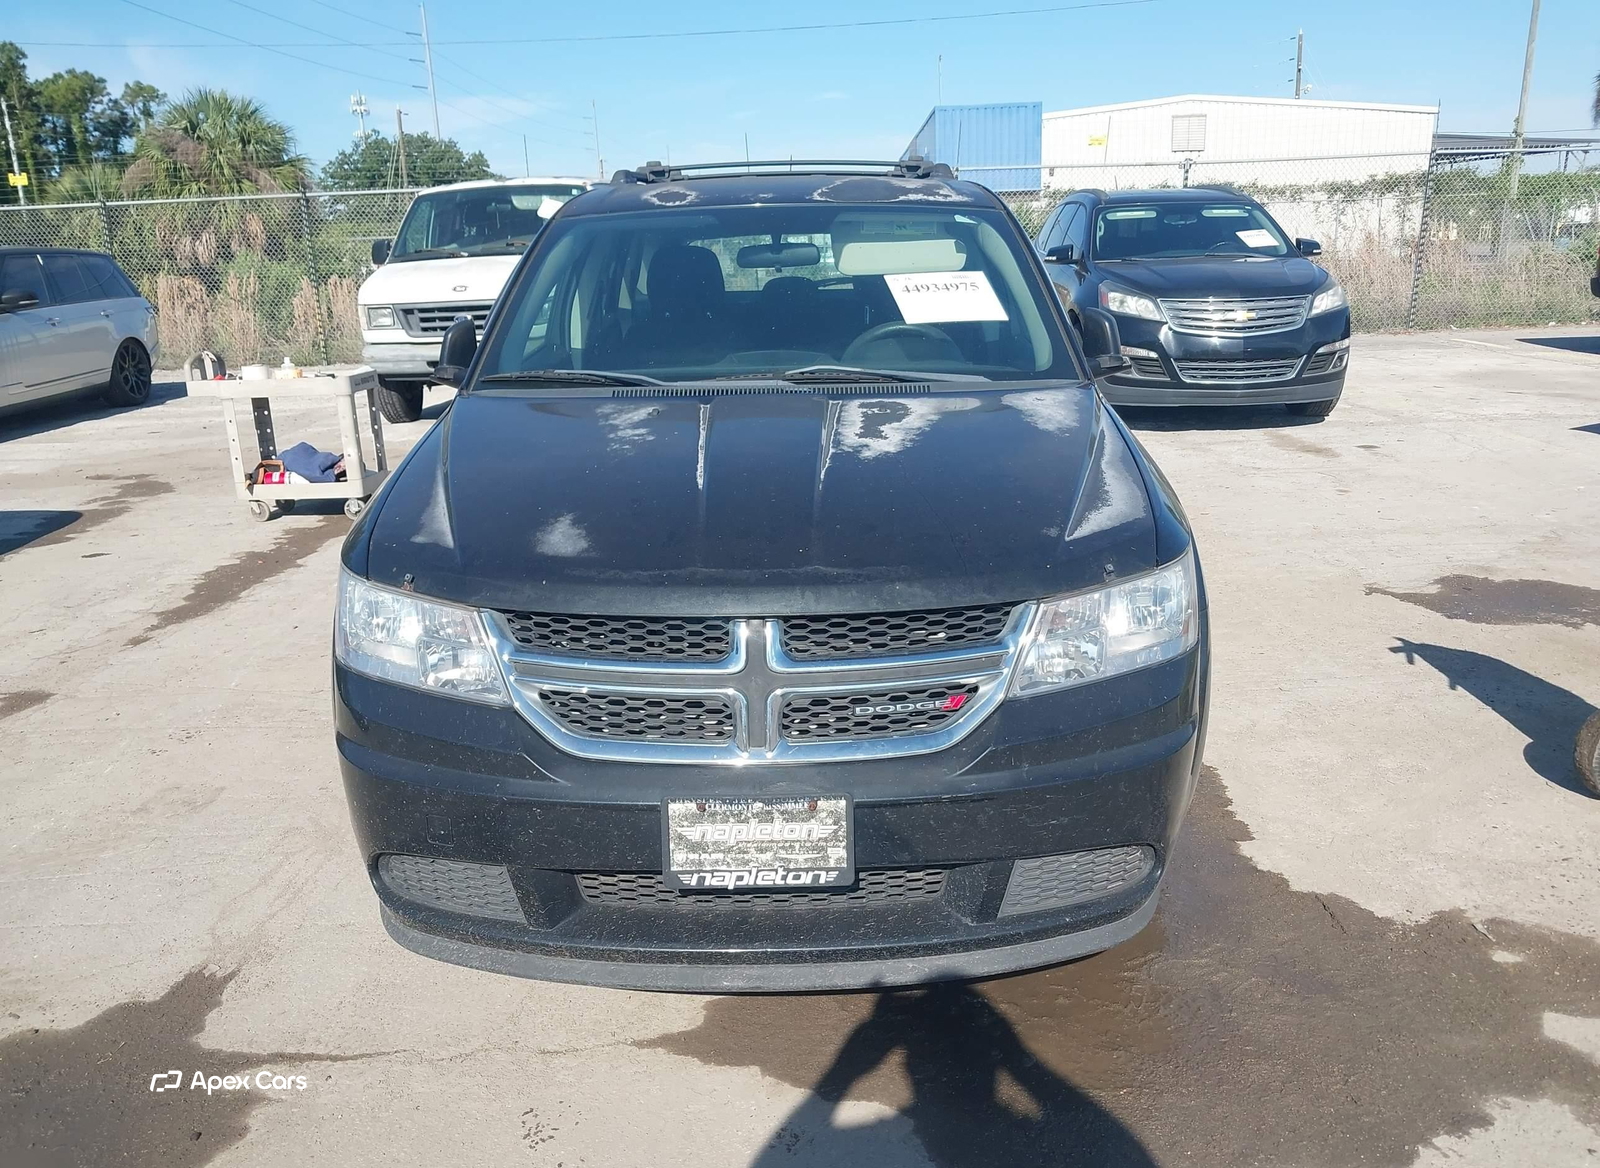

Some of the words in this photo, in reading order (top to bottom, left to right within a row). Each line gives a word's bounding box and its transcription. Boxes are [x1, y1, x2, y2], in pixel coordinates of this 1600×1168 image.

[902, 282, 980, 293] 44934975
[855, 700, 951, 716] DODGE
[692, 819, 820, 844] napleton
[690, 864, 827, 889] napleton
